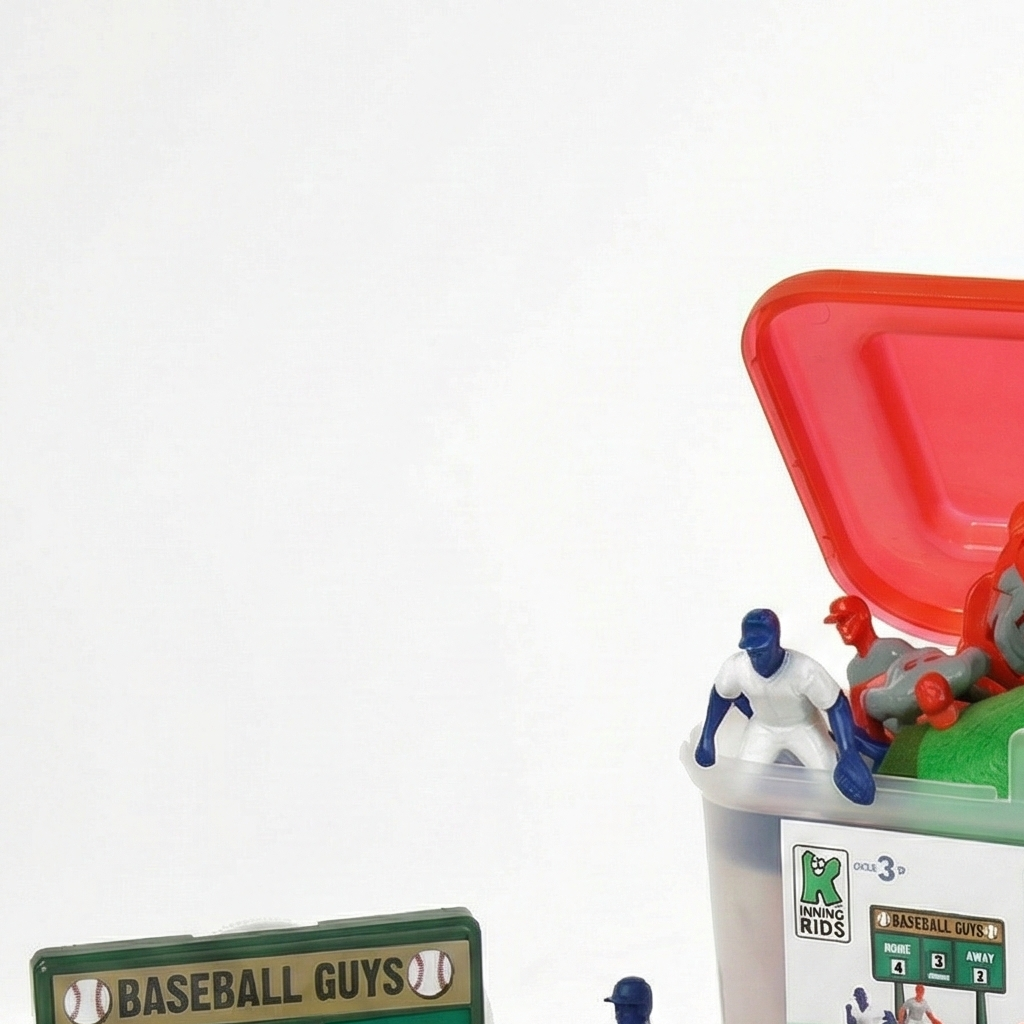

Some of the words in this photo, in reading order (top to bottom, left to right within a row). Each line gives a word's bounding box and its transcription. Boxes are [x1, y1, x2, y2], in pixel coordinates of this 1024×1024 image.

[877, 855, 896, 882] 3
[800, 905, 844, 921] INNING
[800, 918, 845, 938] RIDS
[892, 913, 952, 934] BASEBALL
[955, 921, 984, 938] GUYS
[934, 955, 944, 968] 3
[966, 950, 995, 964] AWAY
[894, 961, 903, 974] 4
[118, 965, 303, 1019] BASEBALL
[314, 956, 404, 1001] GUYS
